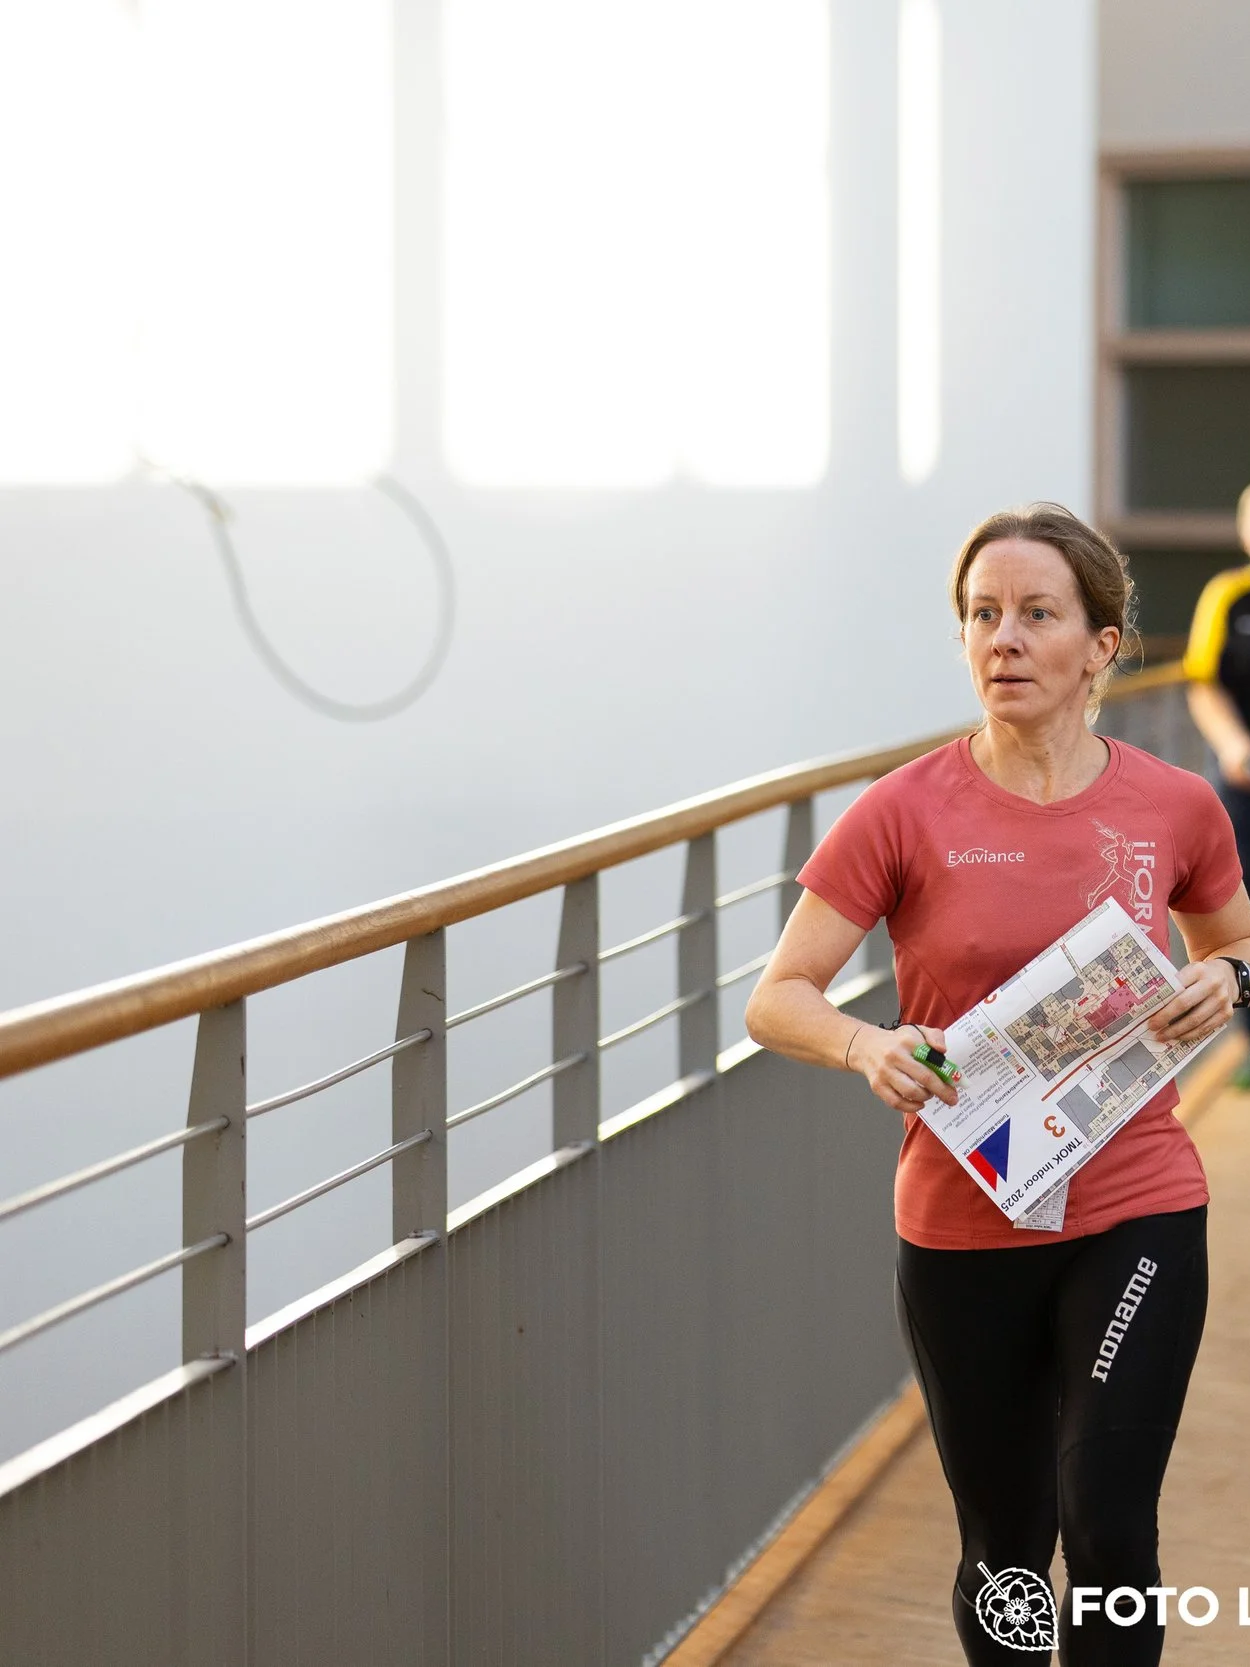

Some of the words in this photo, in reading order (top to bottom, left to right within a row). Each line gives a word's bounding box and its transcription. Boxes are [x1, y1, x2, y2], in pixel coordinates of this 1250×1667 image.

[946, 848, 1025, 867] Exuviance
[1043, 1115, 1066, 1138] 3
[1051, 1136, 1083, 1164] TMOK
[1024, 1161, 1052, 1189] Indoor
[1000, 1187, 1025, 1212] 2025
[1091, 1256, 1158, 1383] noname
